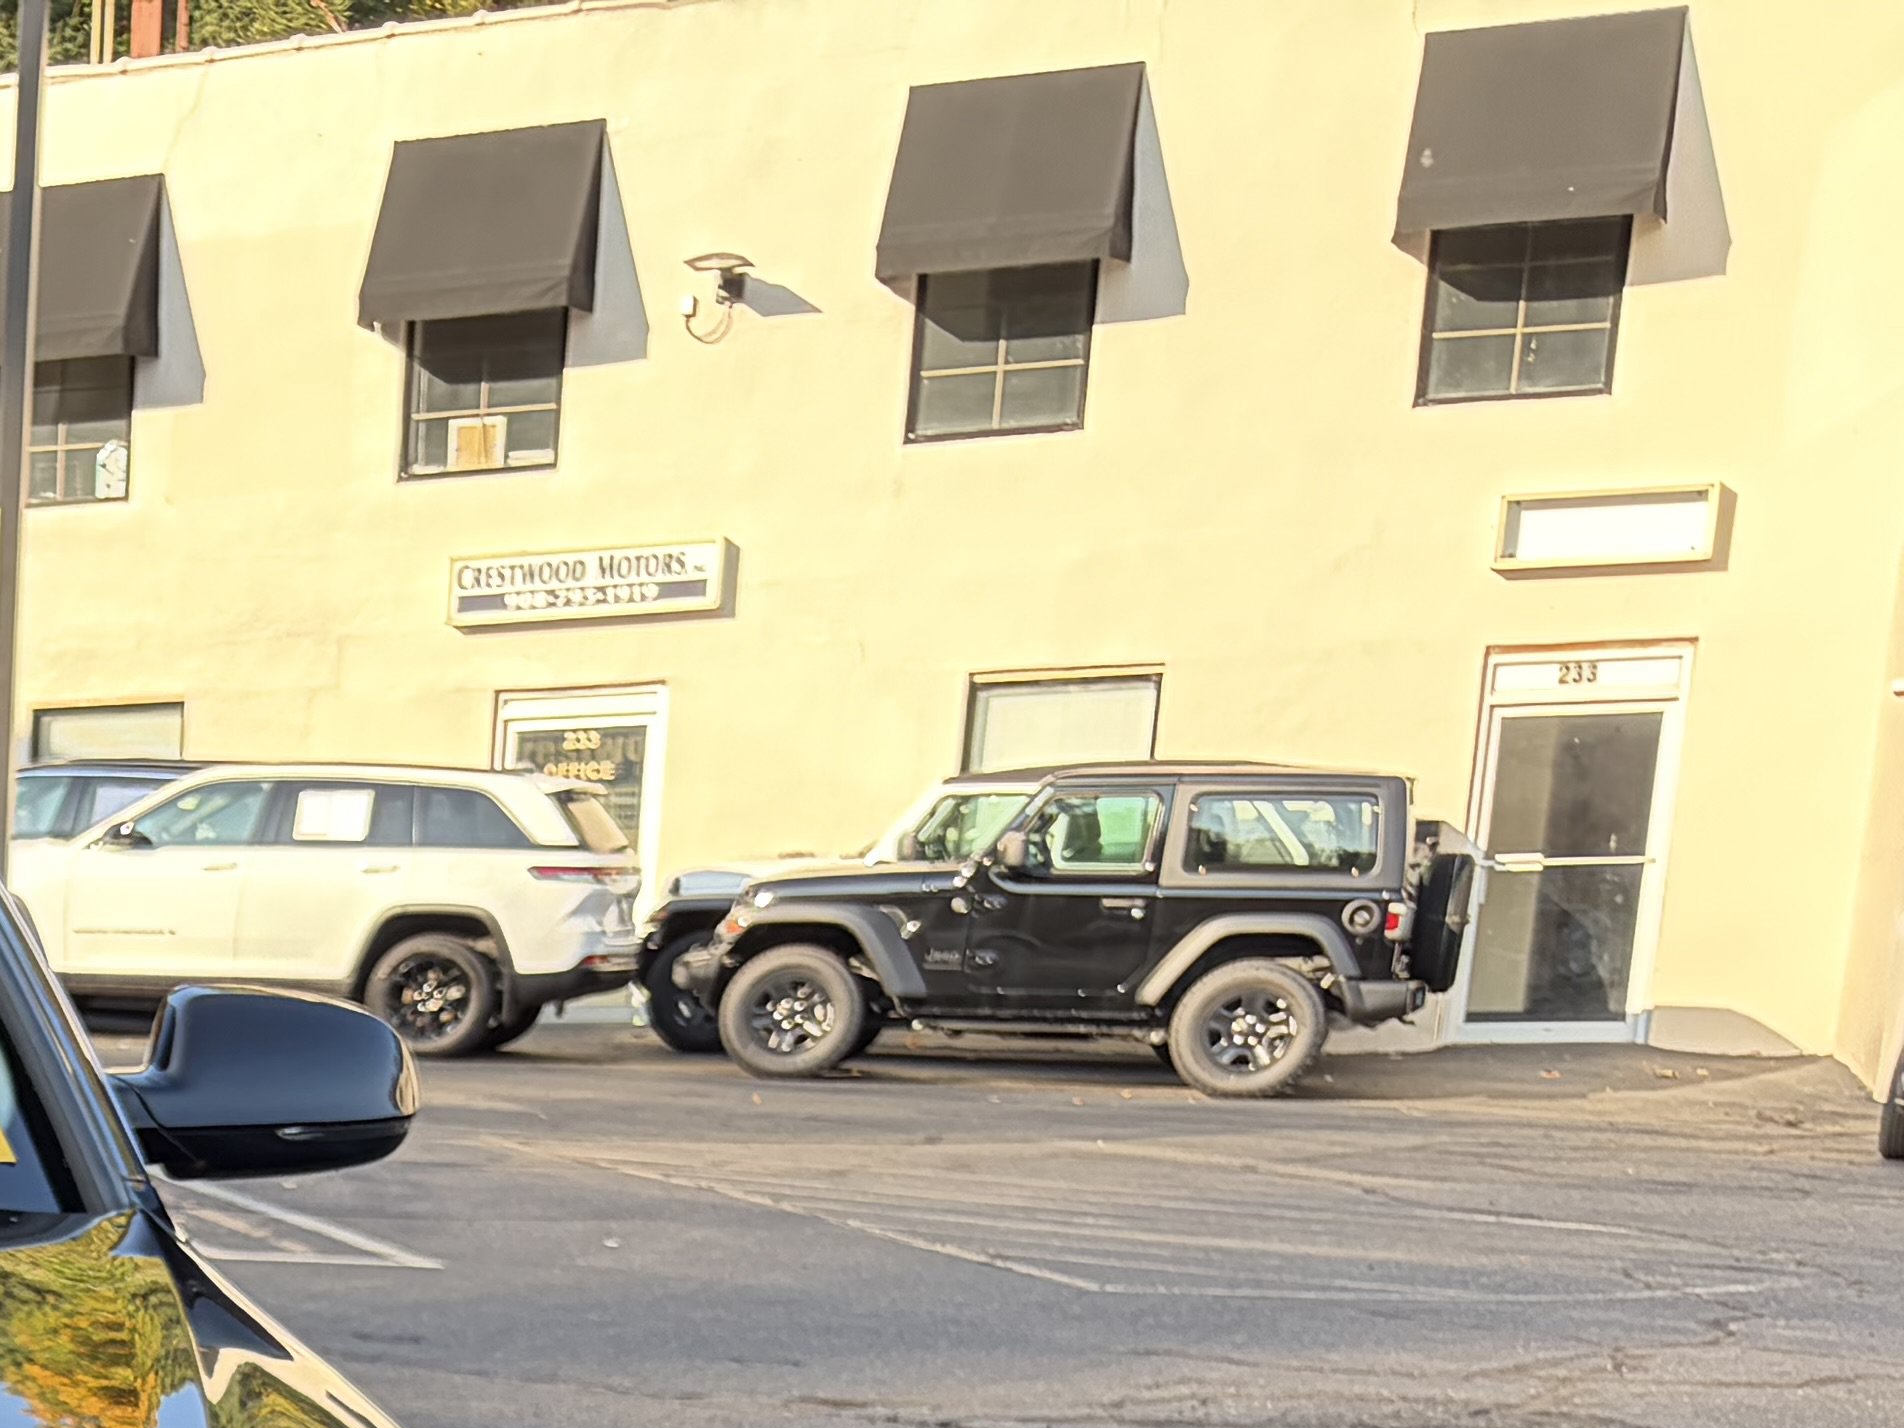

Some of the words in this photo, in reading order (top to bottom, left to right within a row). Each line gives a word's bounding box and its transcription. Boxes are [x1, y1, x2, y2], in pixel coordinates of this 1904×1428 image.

[457, 559, 586, 591] CRESTWOOD
[599, 551, 687, 579] MOTORS
[1558, 662, 1598, 684] 233
